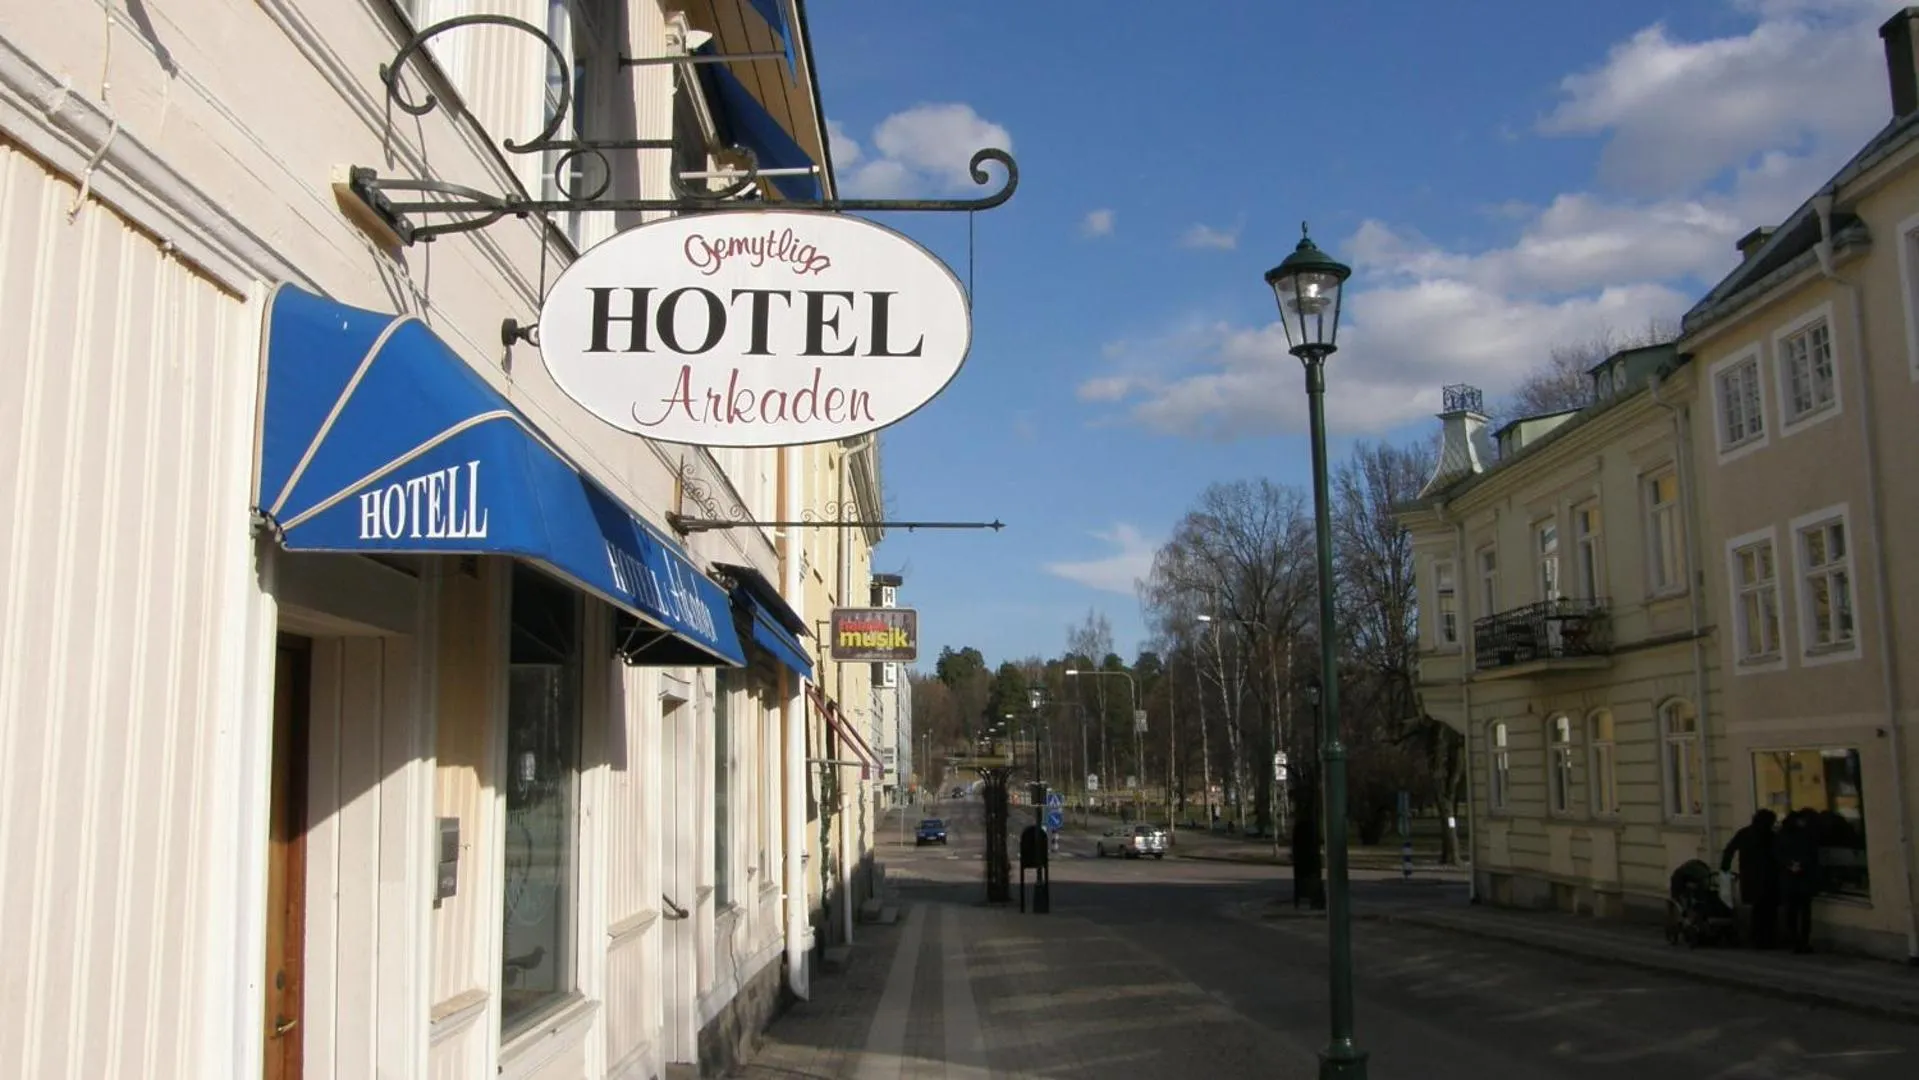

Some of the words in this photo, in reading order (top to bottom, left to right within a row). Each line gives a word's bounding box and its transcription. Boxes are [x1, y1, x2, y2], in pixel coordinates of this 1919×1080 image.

[582, 287, 924, 357] HOTEL
[631, 364, 875, 427] Arkaden
[359, 459, 488, 539] HOTELL
[840, 626, 908, 650] musik
